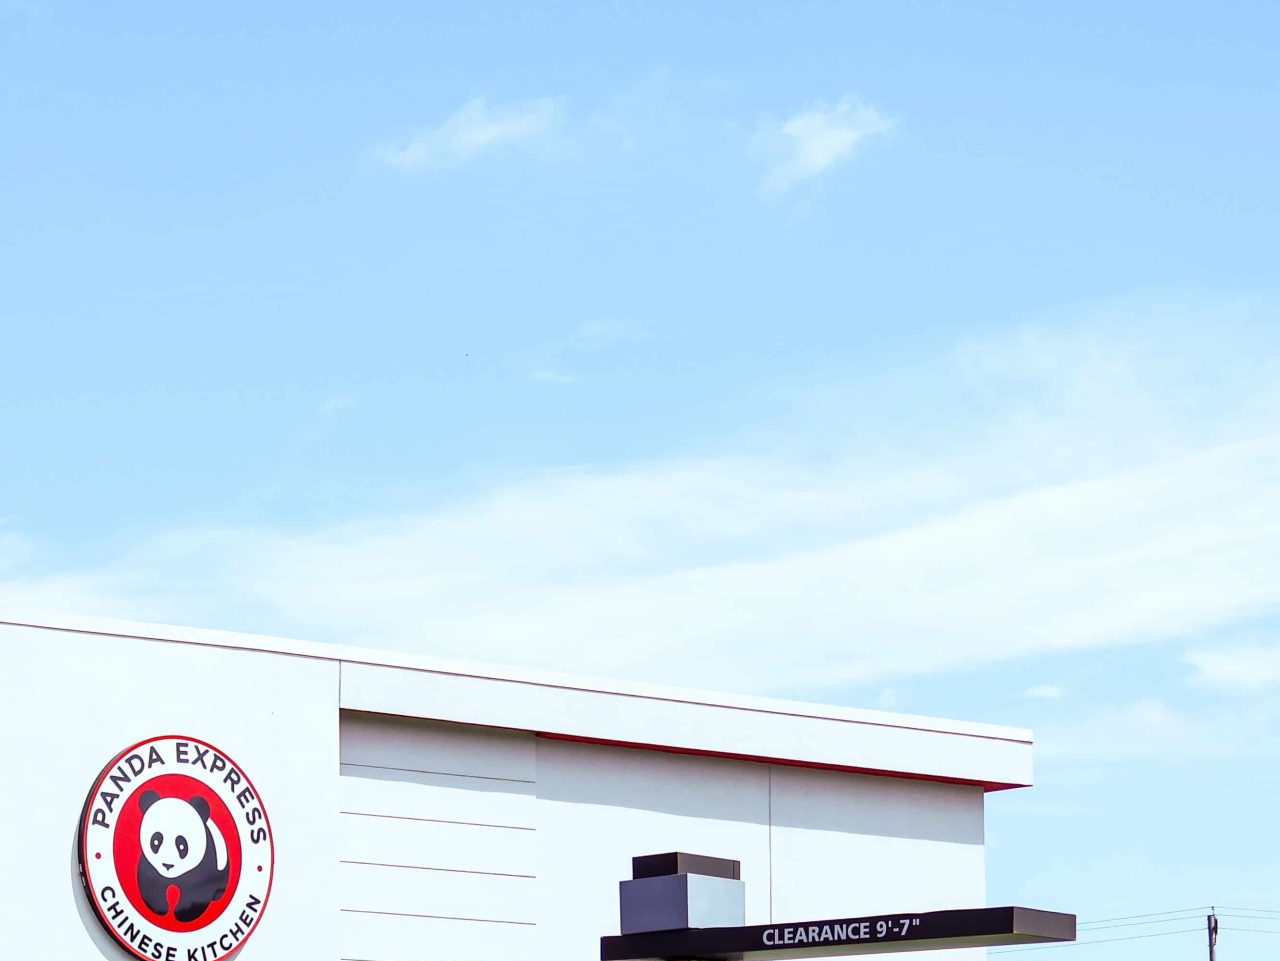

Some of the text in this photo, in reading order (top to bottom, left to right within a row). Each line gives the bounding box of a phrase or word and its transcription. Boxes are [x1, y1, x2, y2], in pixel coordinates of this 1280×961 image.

[92, 742, 267, 845] PANDA EXPRESS
[762, 918, 920, 946] CLEARANCE 9'-7"
